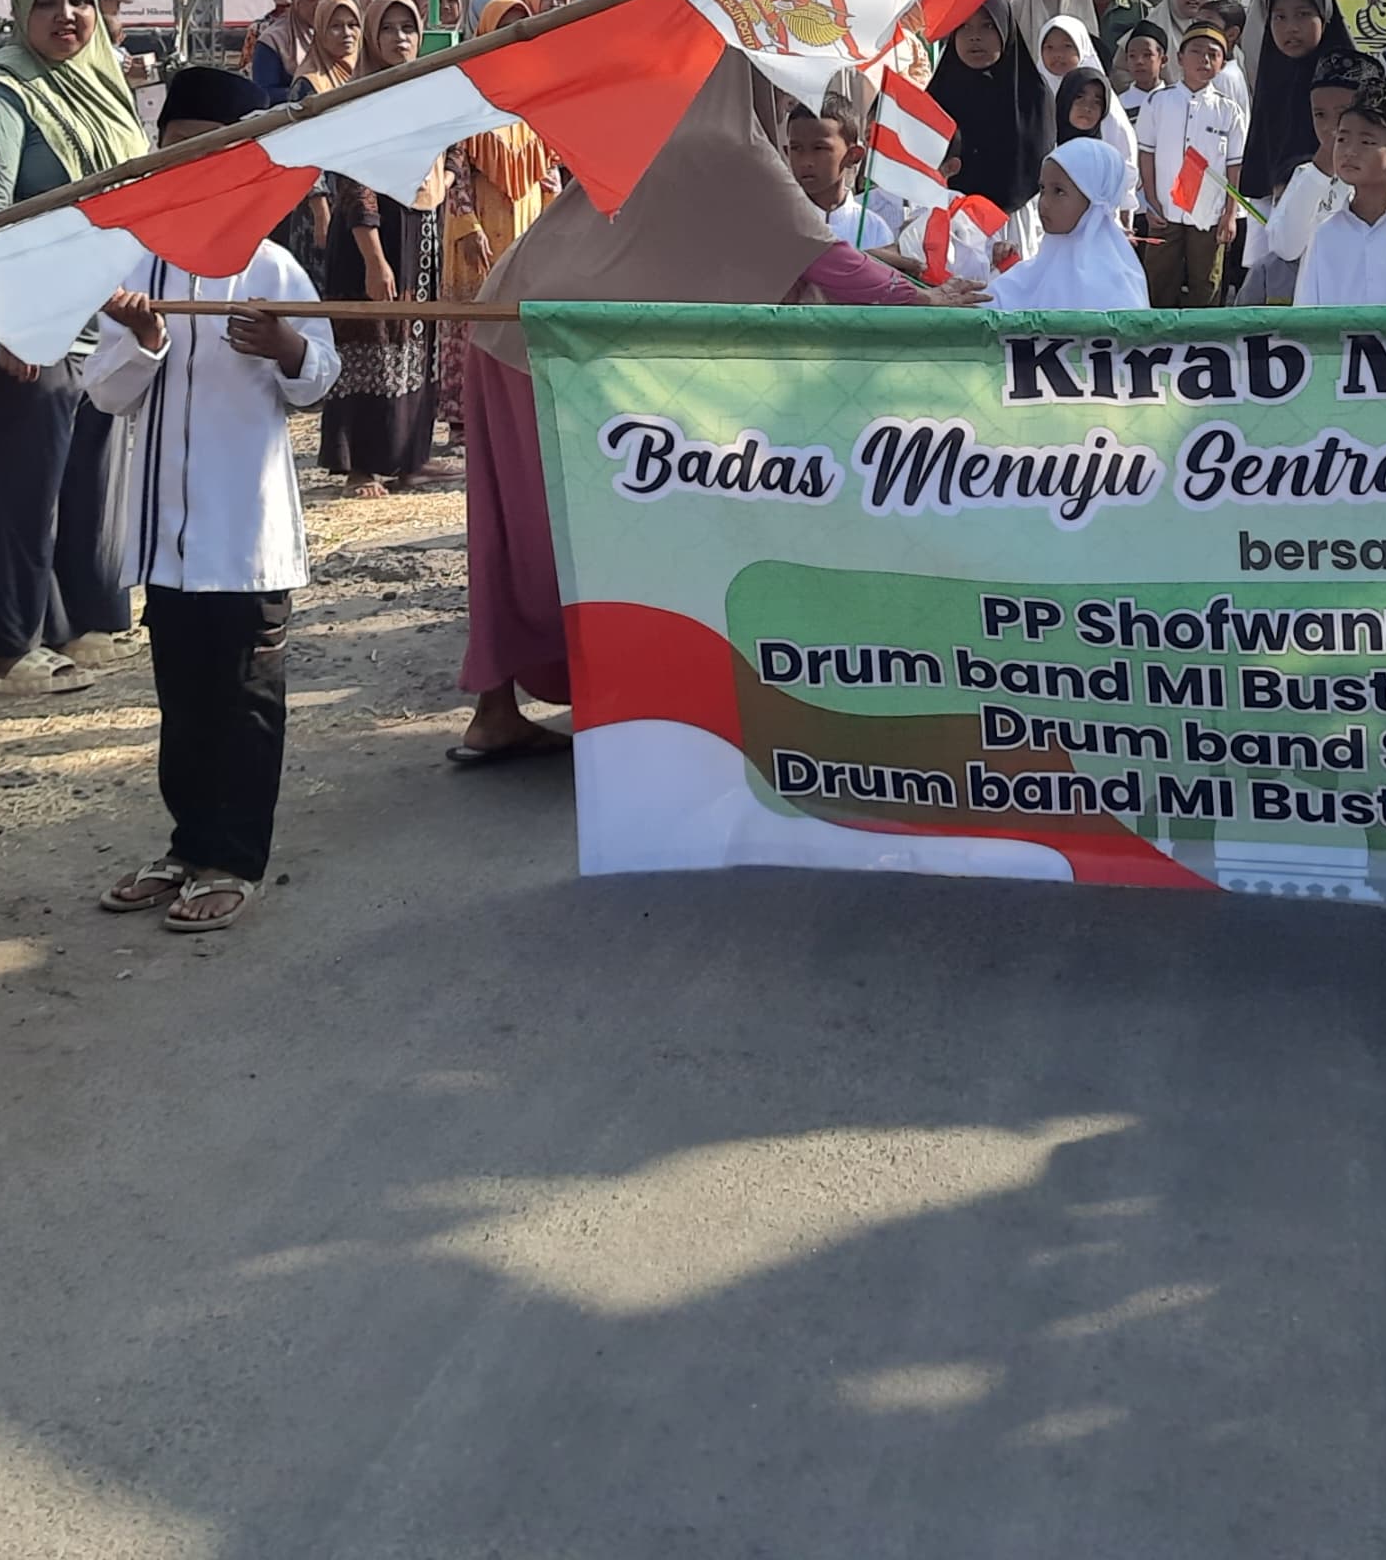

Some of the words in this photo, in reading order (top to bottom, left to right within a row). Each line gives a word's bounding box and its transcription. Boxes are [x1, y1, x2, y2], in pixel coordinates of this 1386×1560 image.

[1008, 336, 1306, 401] Kirab
[609, 422, 835, 497] Badas
[860, 426, 1155, 521] Menuju
[984, 596, 1062, 642] PP
[760, 641, 941, 690] Drum
[958, 648, 1130, 704] band
[1150, 666, 1224, 708] MI
[984, 706, 1170, 760] Drum
[1187, 719, 1364, 771] band
[776, 751, 956, 806] Drum
[970, 761, 1141, 814] band
[1161, 777, 1234, 820] MI
